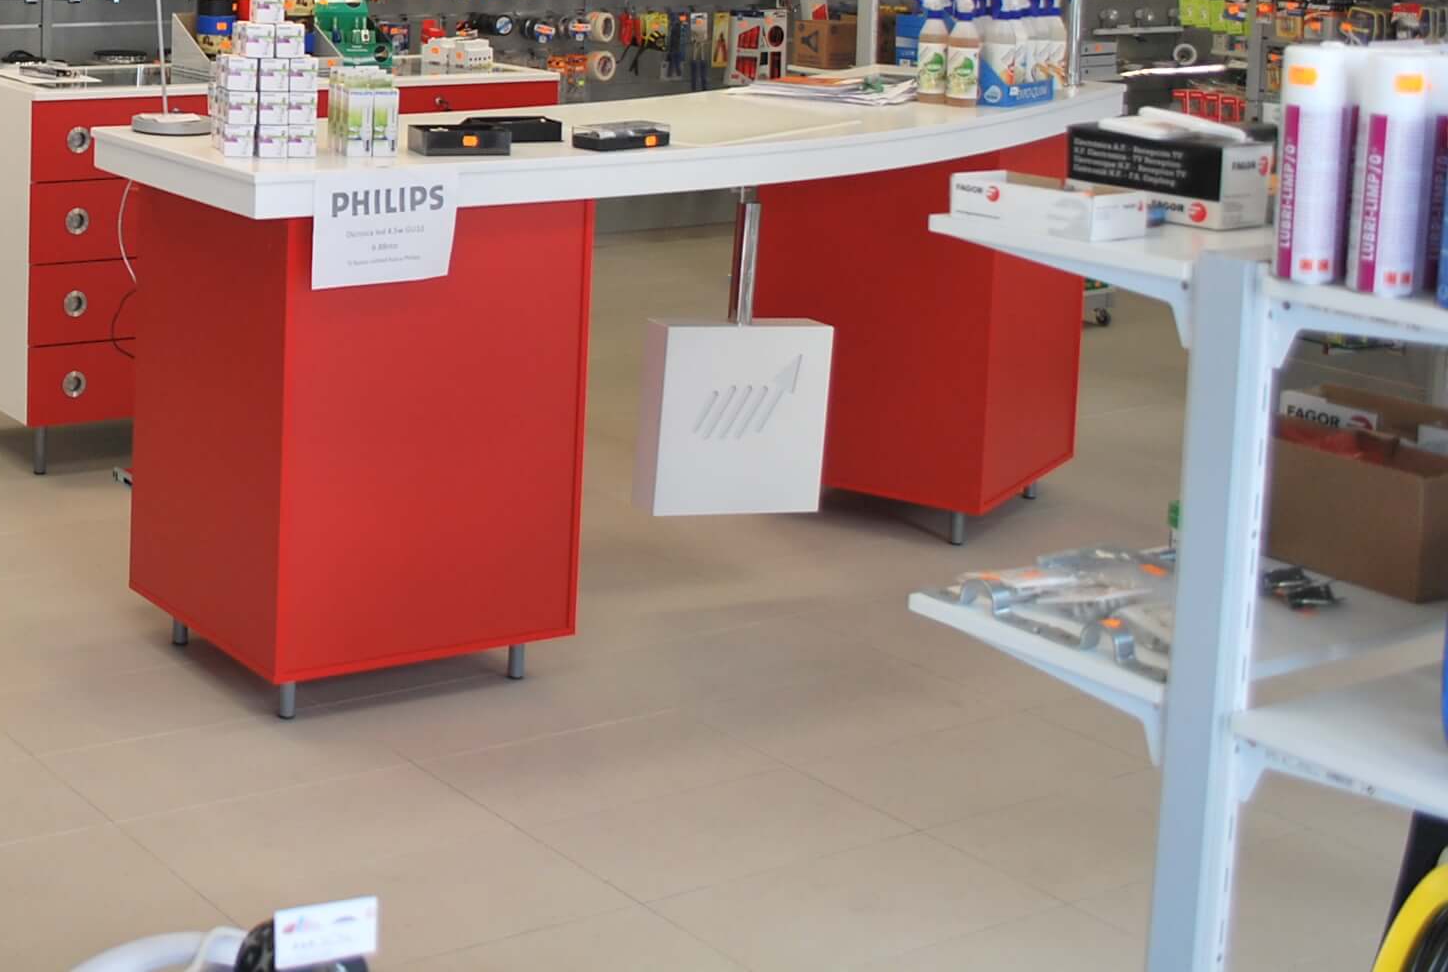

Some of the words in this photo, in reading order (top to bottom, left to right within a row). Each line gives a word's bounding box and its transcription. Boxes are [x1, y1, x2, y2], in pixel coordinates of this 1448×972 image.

[1231, 159, 1256, 171] FAGOR
[955, 182, 984, 195] FAGOR
[331, 184, 445, 218] PHILIPS
[1286, 404, 1341, 428] FAGOR
